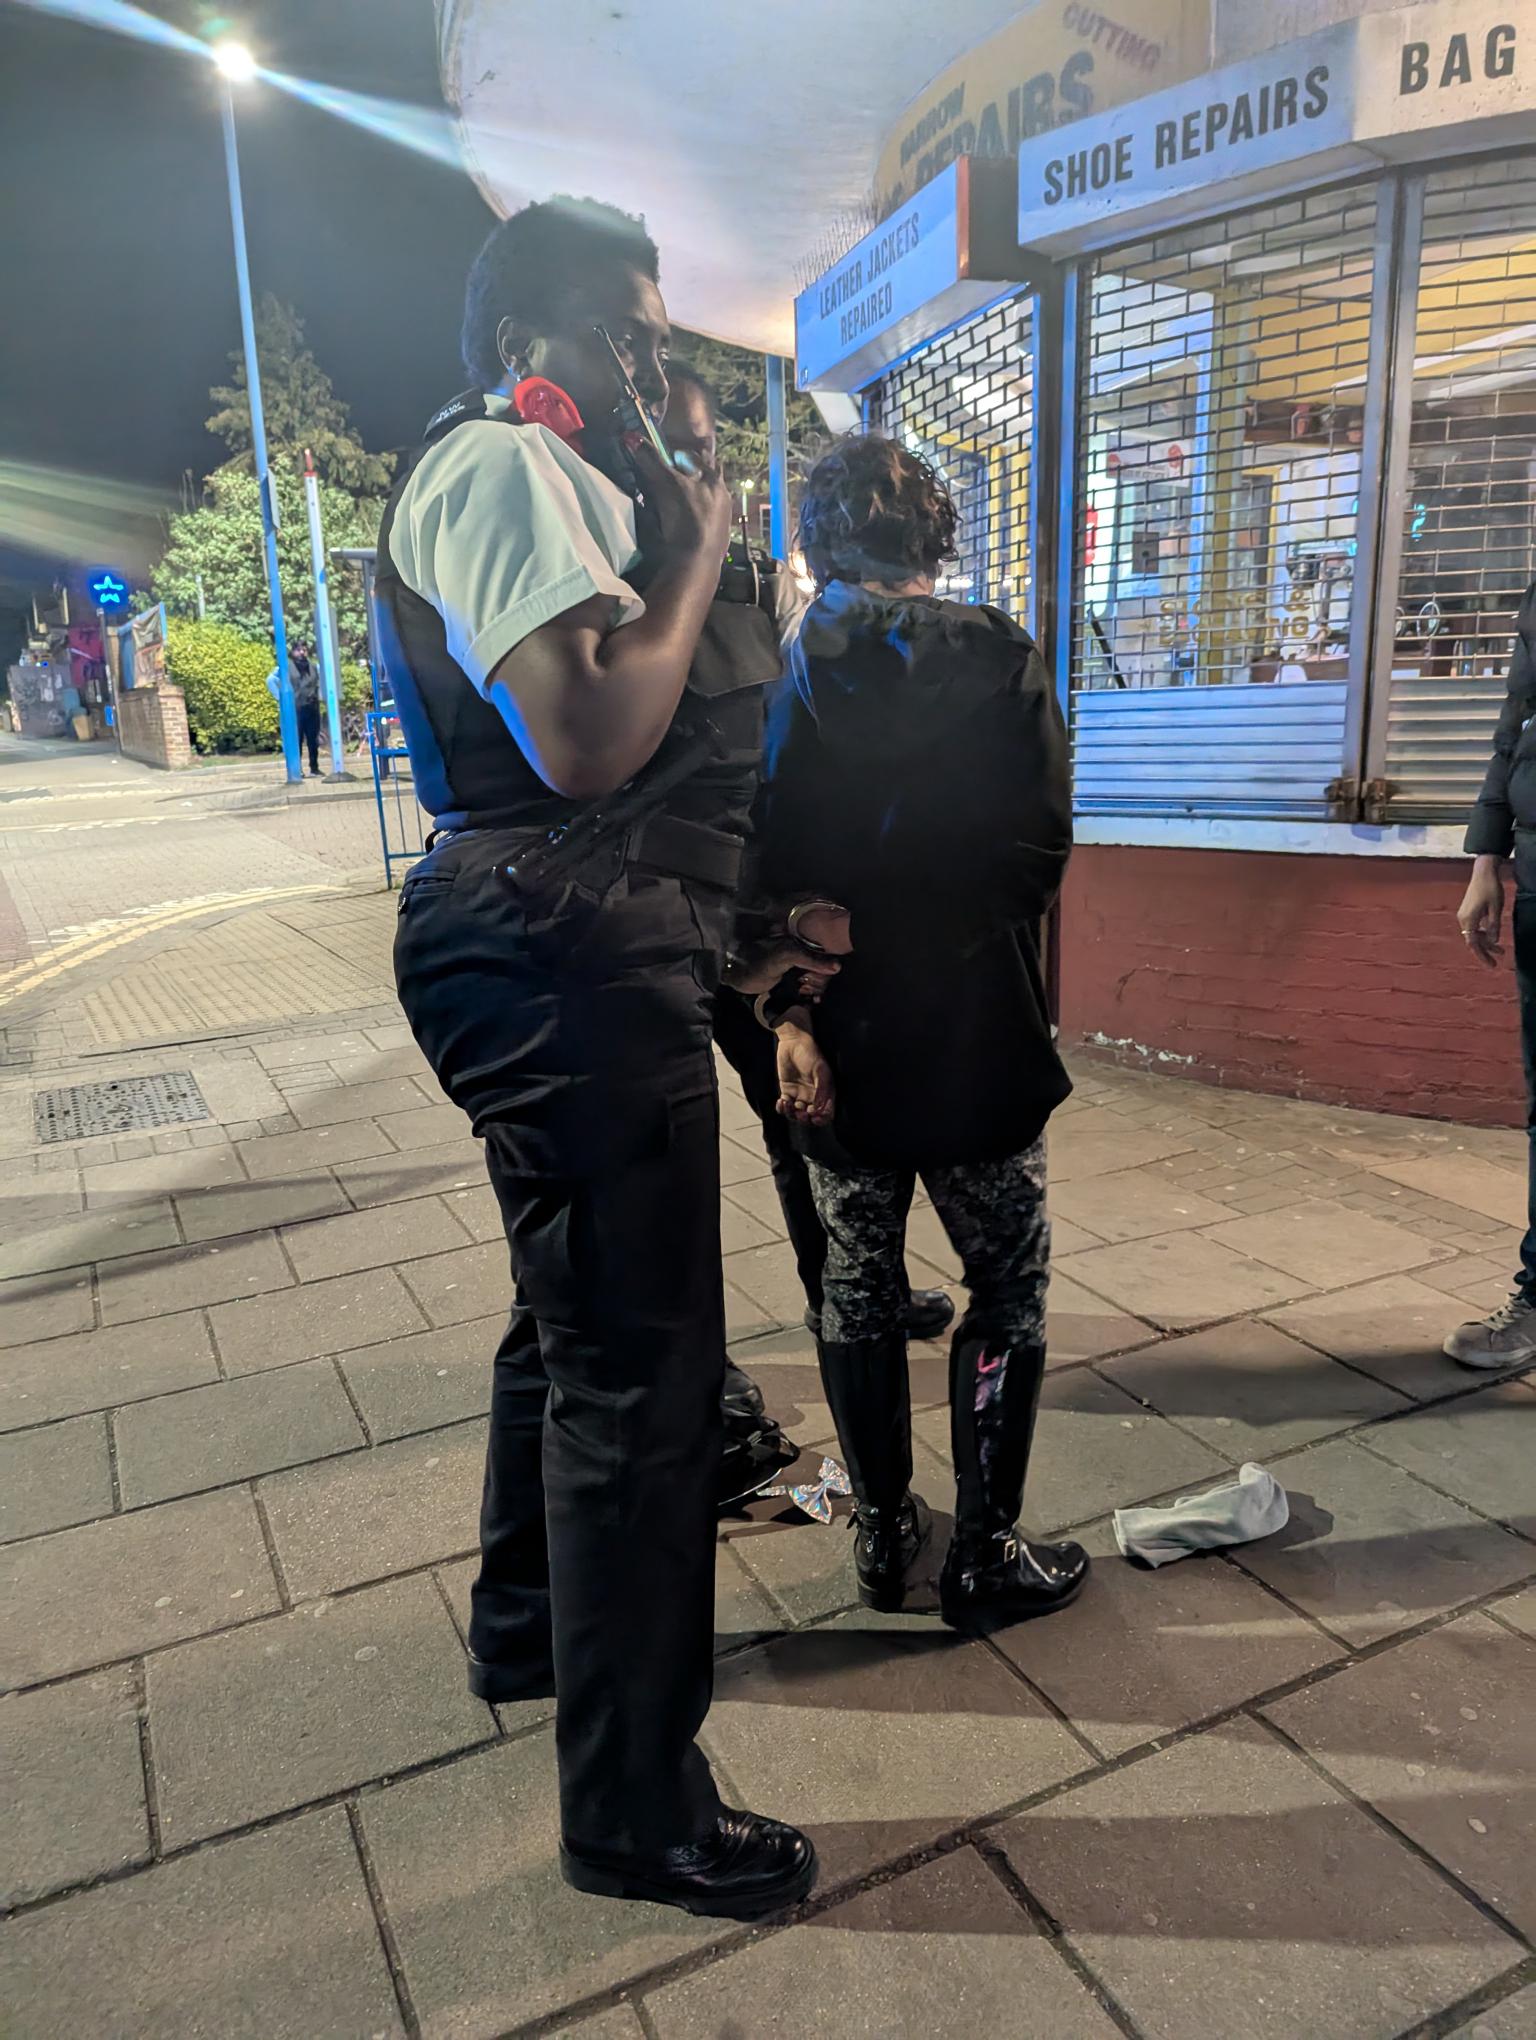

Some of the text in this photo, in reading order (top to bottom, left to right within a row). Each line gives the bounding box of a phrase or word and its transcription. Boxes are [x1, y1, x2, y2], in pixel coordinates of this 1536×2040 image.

[1062, 2, 1161, 71] CUTTING
[1399, 24, 1516, 95] BAG
[1044, 66, 1329, 205] SHOE REPAIRS
[820, 212, 919, 320] LEATHER JACKETS
[841, 281, 892, 346] REPAIRED
